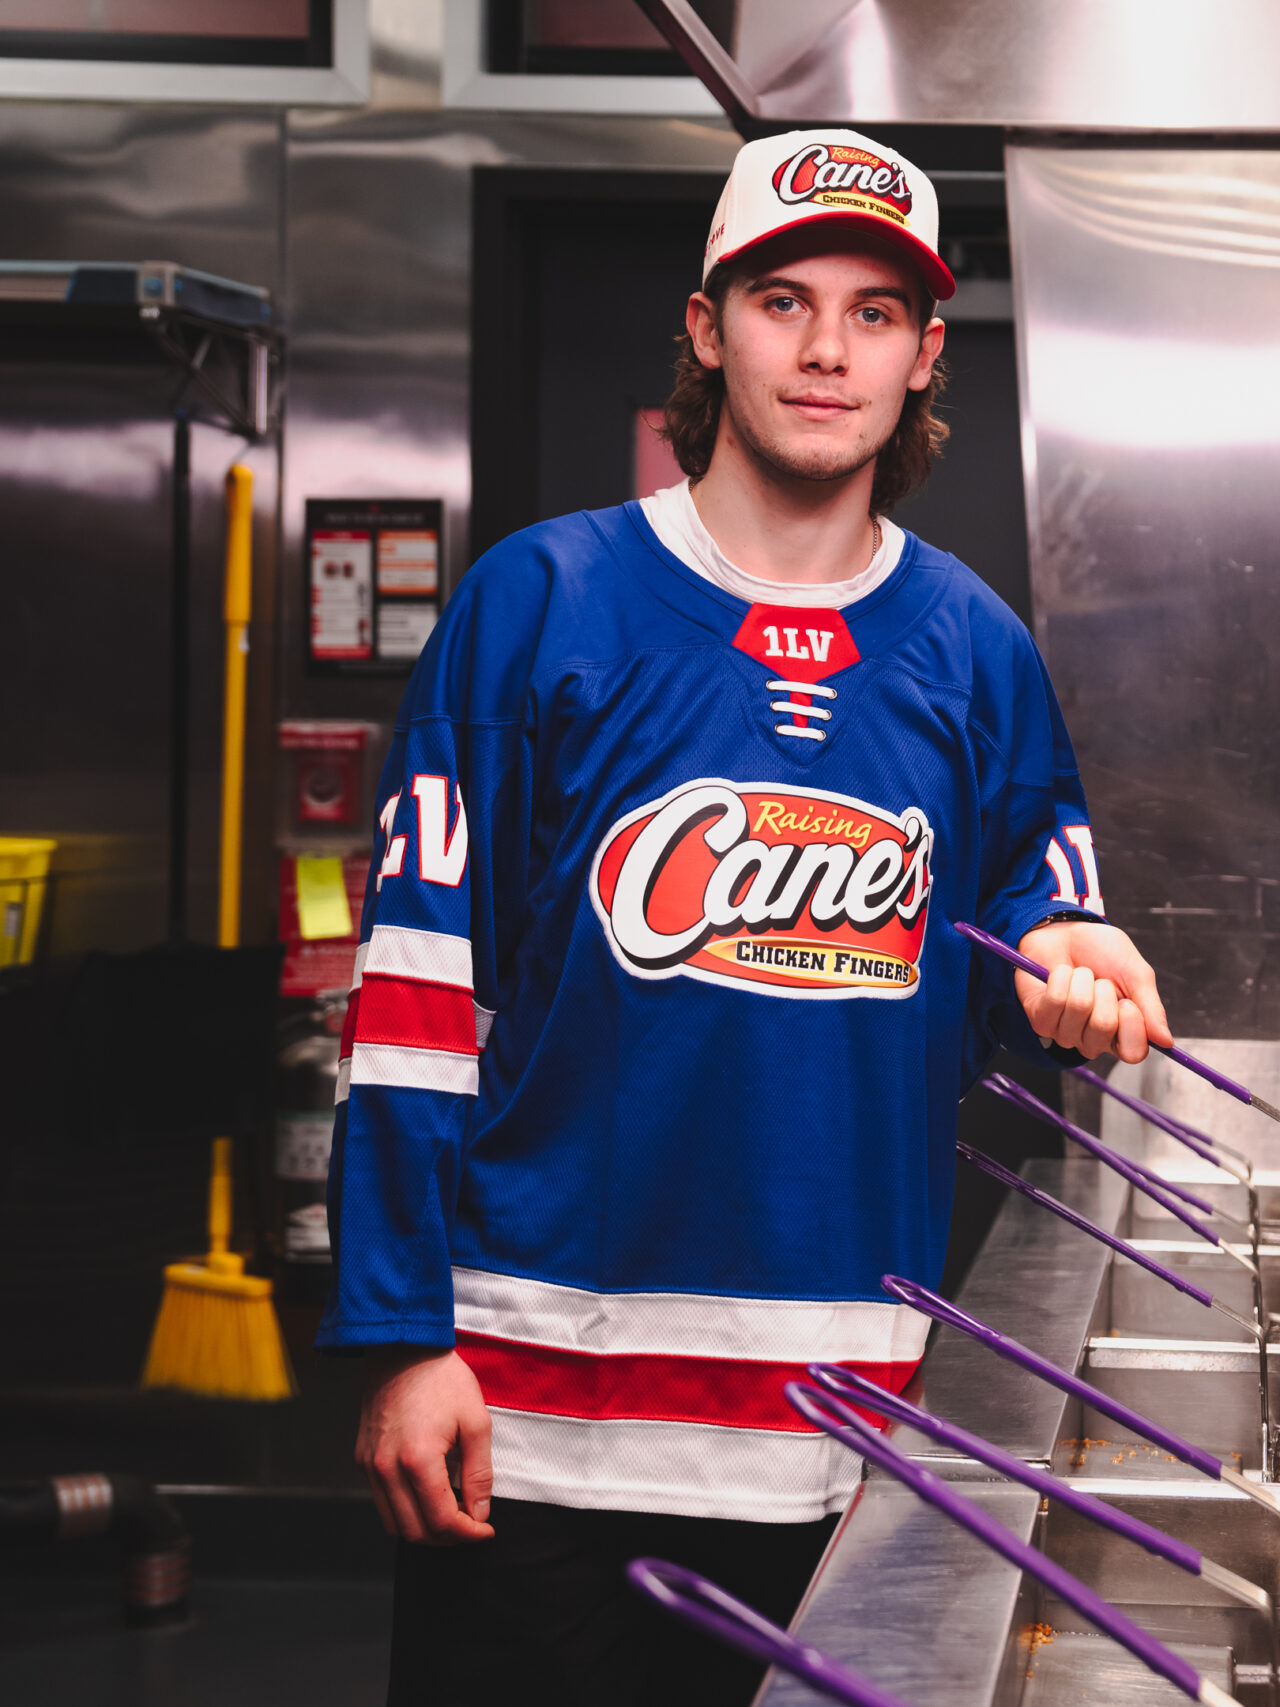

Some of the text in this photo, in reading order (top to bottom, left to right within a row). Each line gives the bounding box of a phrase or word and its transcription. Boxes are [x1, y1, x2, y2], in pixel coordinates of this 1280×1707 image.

[779, 144, 911, 204] Cane's
[831, 146, 880, 168] Raising
[822, 194, 905, 225] CHICKEN FINGERS
[762, 625, 834, 662] 1LV
[753, 800, 873, 848] Raising
[611, 785, 930, 966] Cane's
[736, 941, 910, 983] CHICKEN FINGERS
